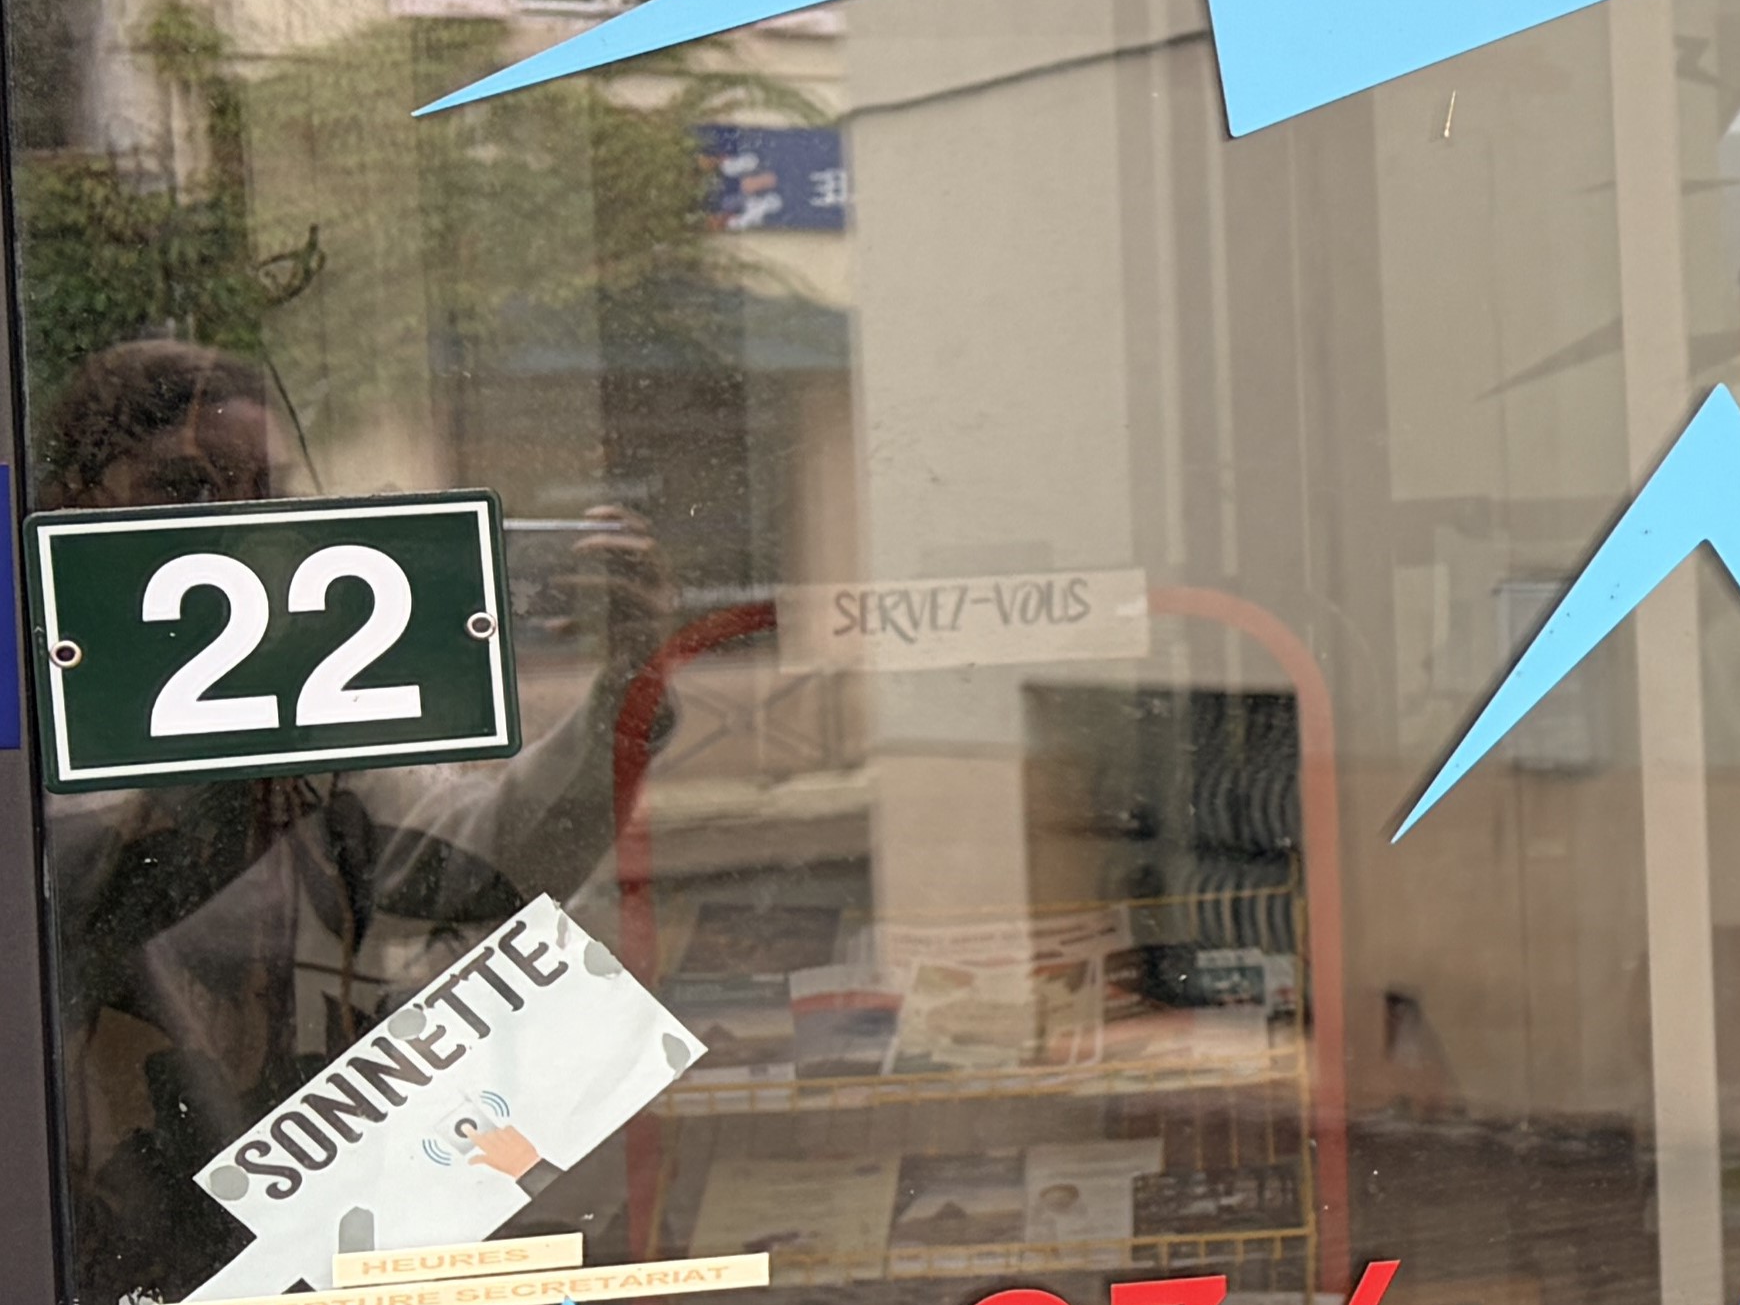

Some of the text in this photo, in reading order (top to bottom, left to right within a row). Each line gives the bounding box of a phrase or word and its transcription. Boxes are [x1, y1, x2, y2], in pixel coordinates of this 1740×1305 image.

[142, 543, 423, 739] 22
[234, 919, 569, 1202] SONNETTE
[361, 1246, 531, 1276] HEURES
[456, 1263, 731, 1305] SECRETARIAT
